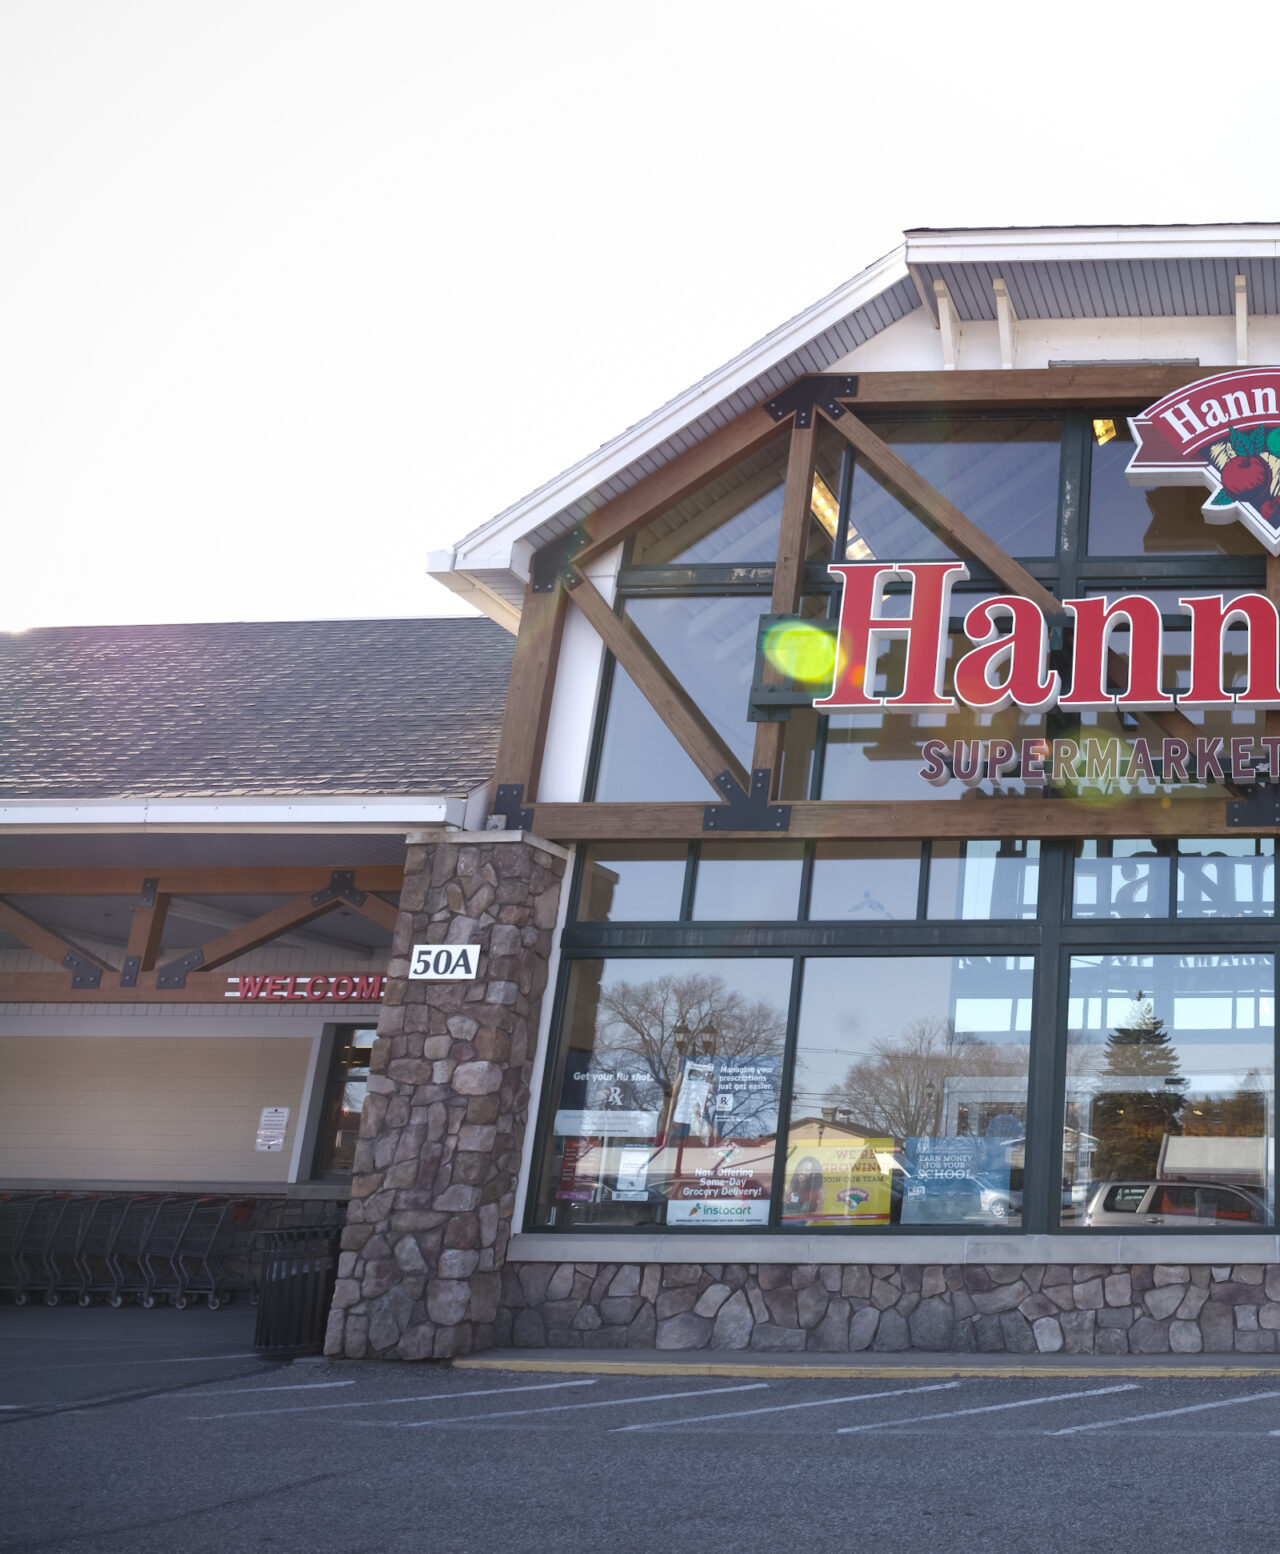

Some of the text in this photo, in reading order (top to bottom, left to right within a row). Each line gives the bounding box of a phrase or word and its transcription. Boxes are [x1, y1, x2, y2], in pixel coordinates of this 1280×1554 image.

[413, 949, 472, 975] 50A
[237, 975, 388, 1000] WELCOM
[720, 1066, 755, 1074] Managing
[757, 1067, 774, 1075] your
[573, 1071, 590, 1081] Get
[592, 1073, 613, 1083] your
[616, 1071, 629, 1081] flu
[719, 1074, 767, 1083] prescriptions
[718, 1083, 733, 1091] just
[920, 1154, 973, 1162] EARN MONEY
[924, 1161, 966, 1169] FOR YOUR
[694, 1168, 754, 1178] Now Offering
[918, 1168, 972, 1180] SCHOOL
[699, 1178, 747, 1188] Same-Day
[683, 1187, 762, 1197] Grocery Delivery!
[703, 1205, 752, 1215] instacart
